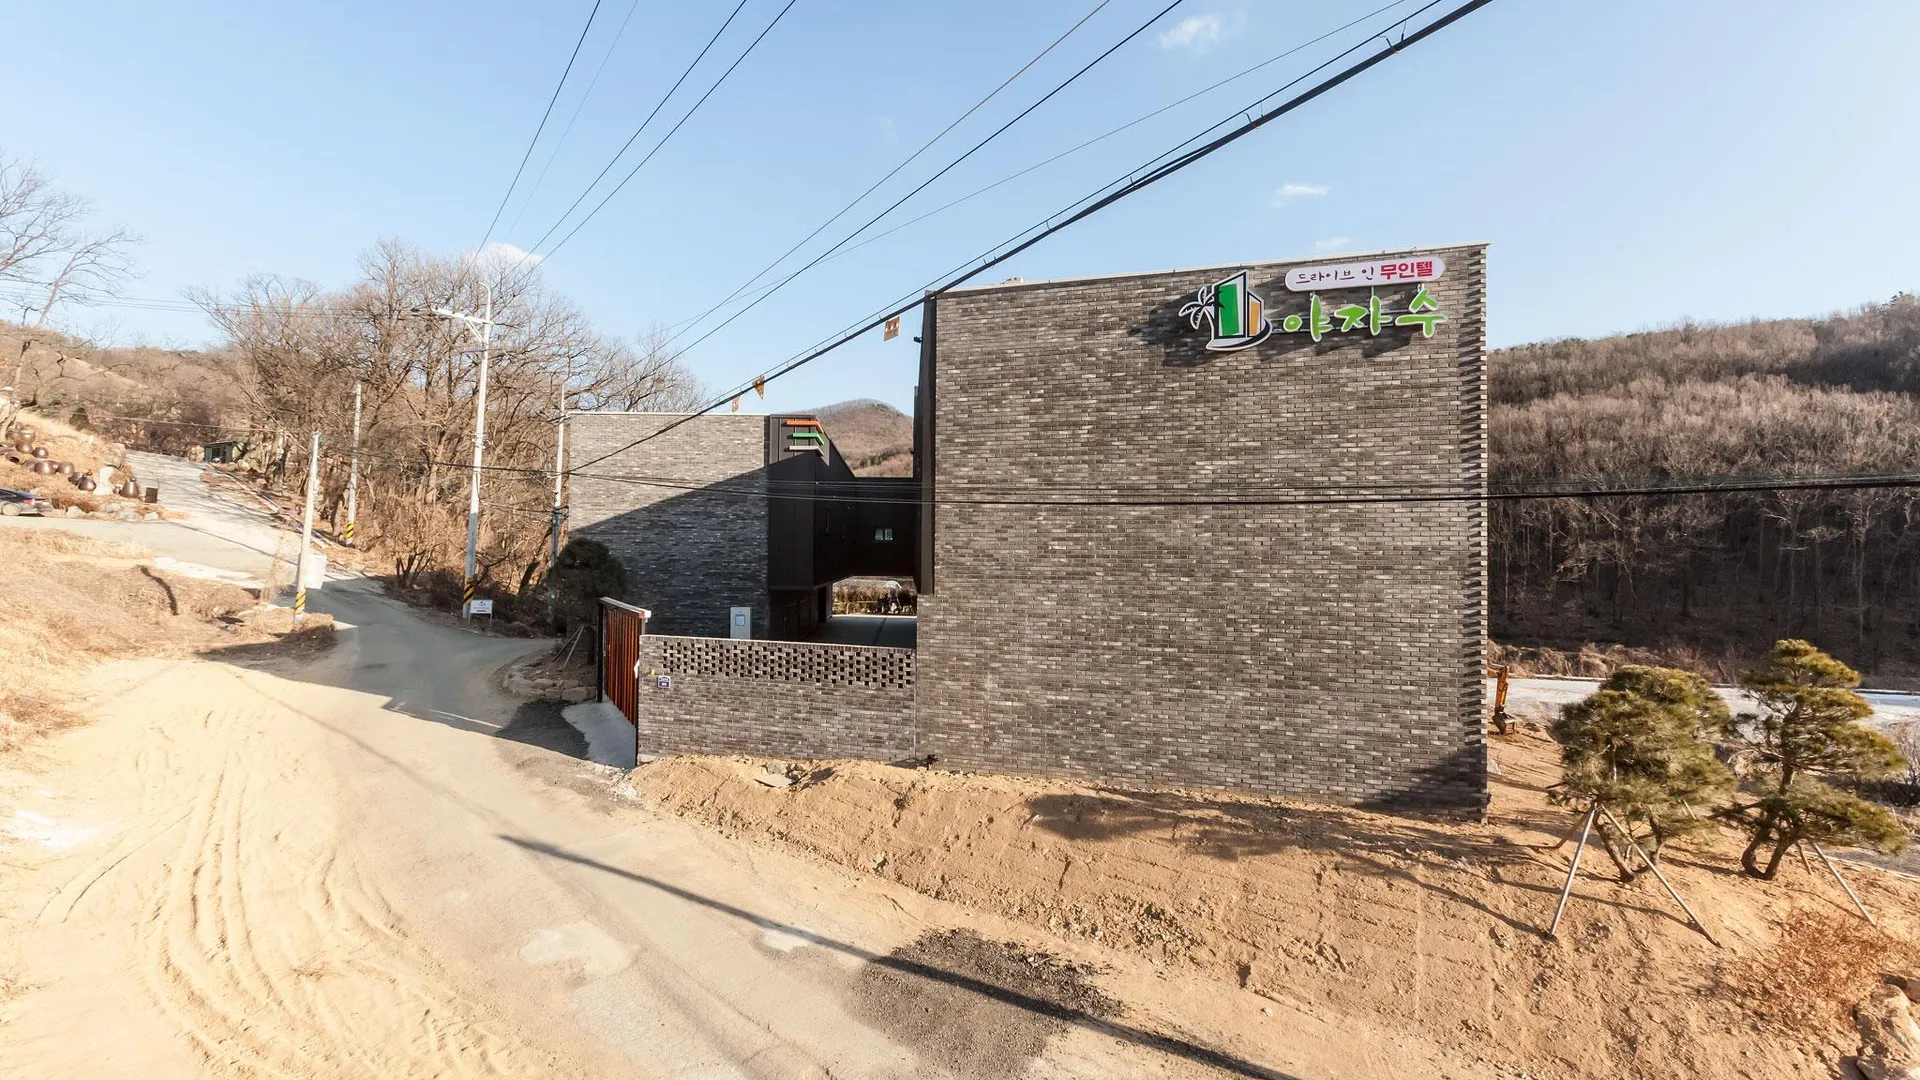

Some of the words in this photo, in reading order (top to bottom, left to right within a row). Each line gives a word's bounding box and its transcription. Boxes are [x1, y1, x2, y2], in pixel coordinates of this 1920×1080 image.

[1295, 269, 1355, 284] 드라이브
[1361, 266, 1374, 281] 인
[1380, 260, 1433, 280] 무인텔
[1283, 288, 1448, 342] 야자수
